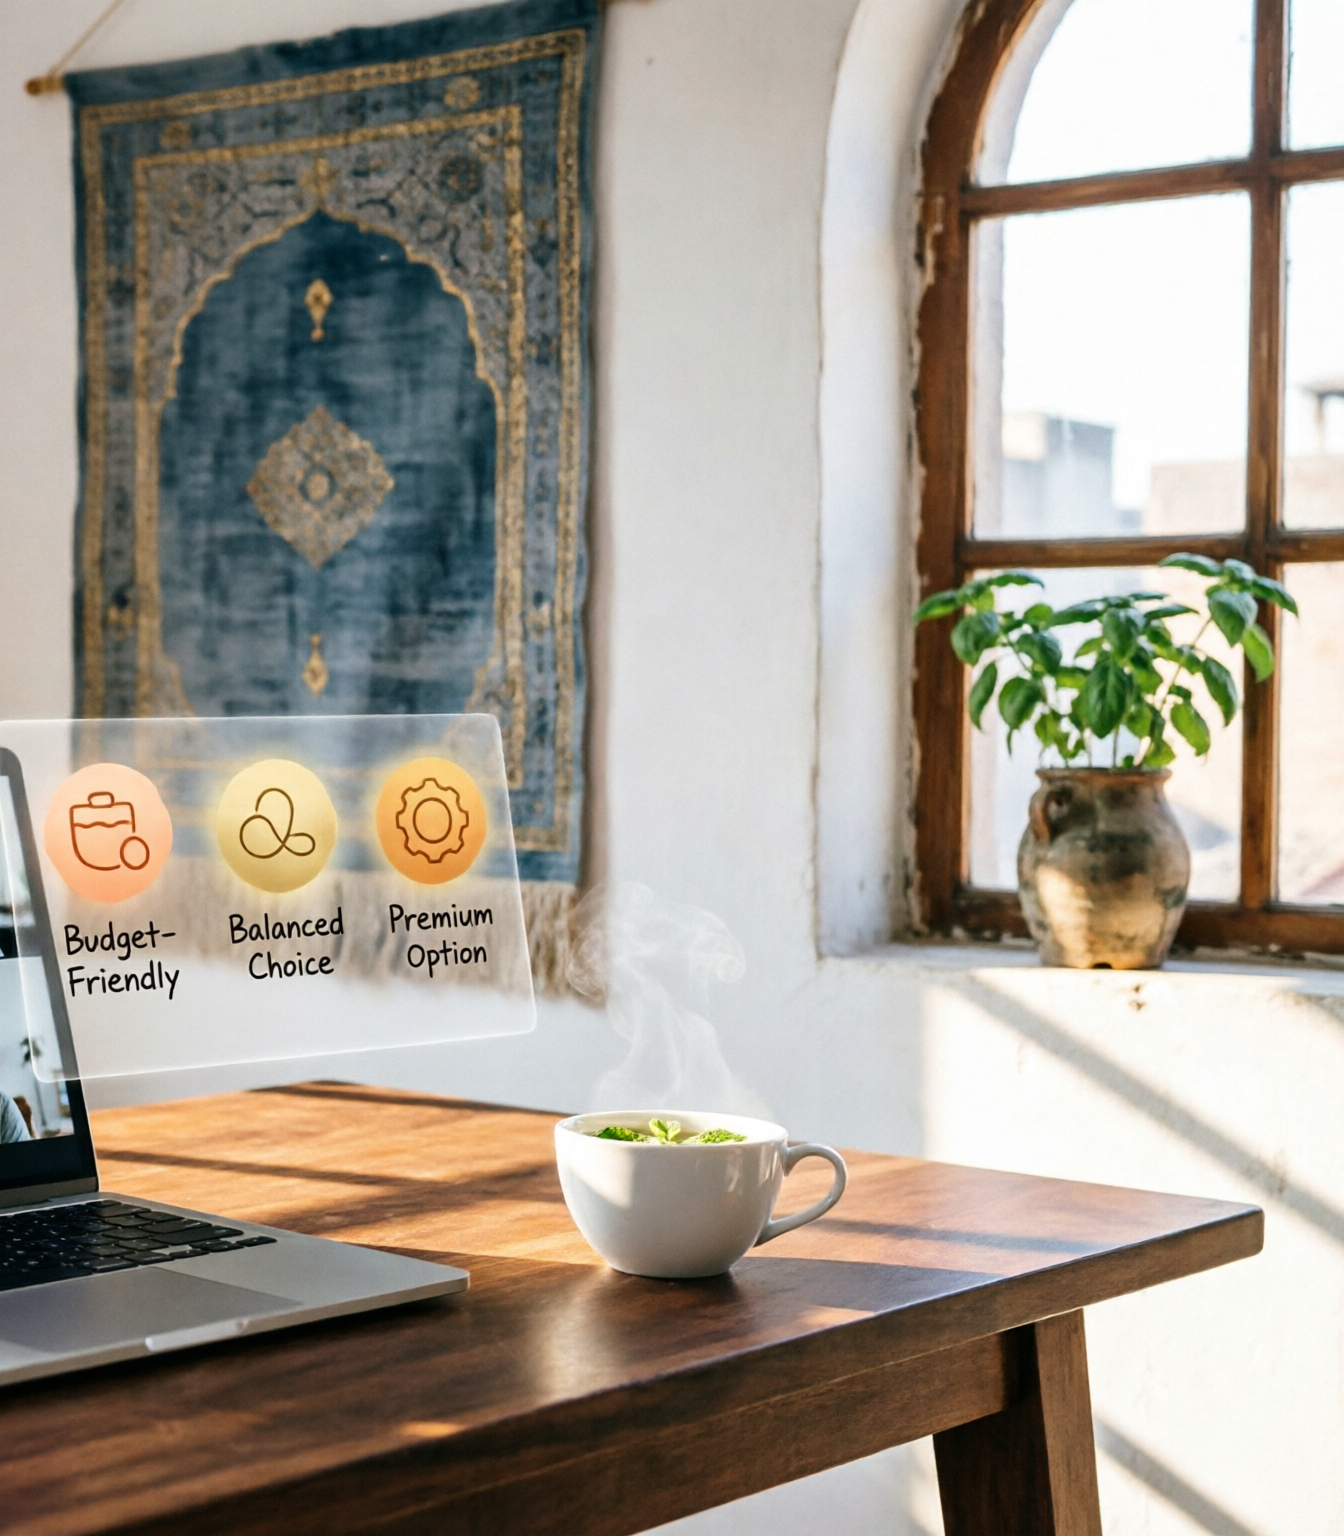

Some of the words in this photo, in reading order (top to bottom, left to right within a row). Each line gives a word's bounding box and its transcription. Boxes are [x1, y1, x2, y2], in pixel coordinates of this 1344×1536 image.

[228, 906, 345, 944] Balanced
[389, 903, 493, 934] Premium
[64, 921, 176, 961] Budget-
[407, 939, 487, 979] Option
[67, 959, 180, 1000] Friendly
[248, 951, 335, 980] Choice
